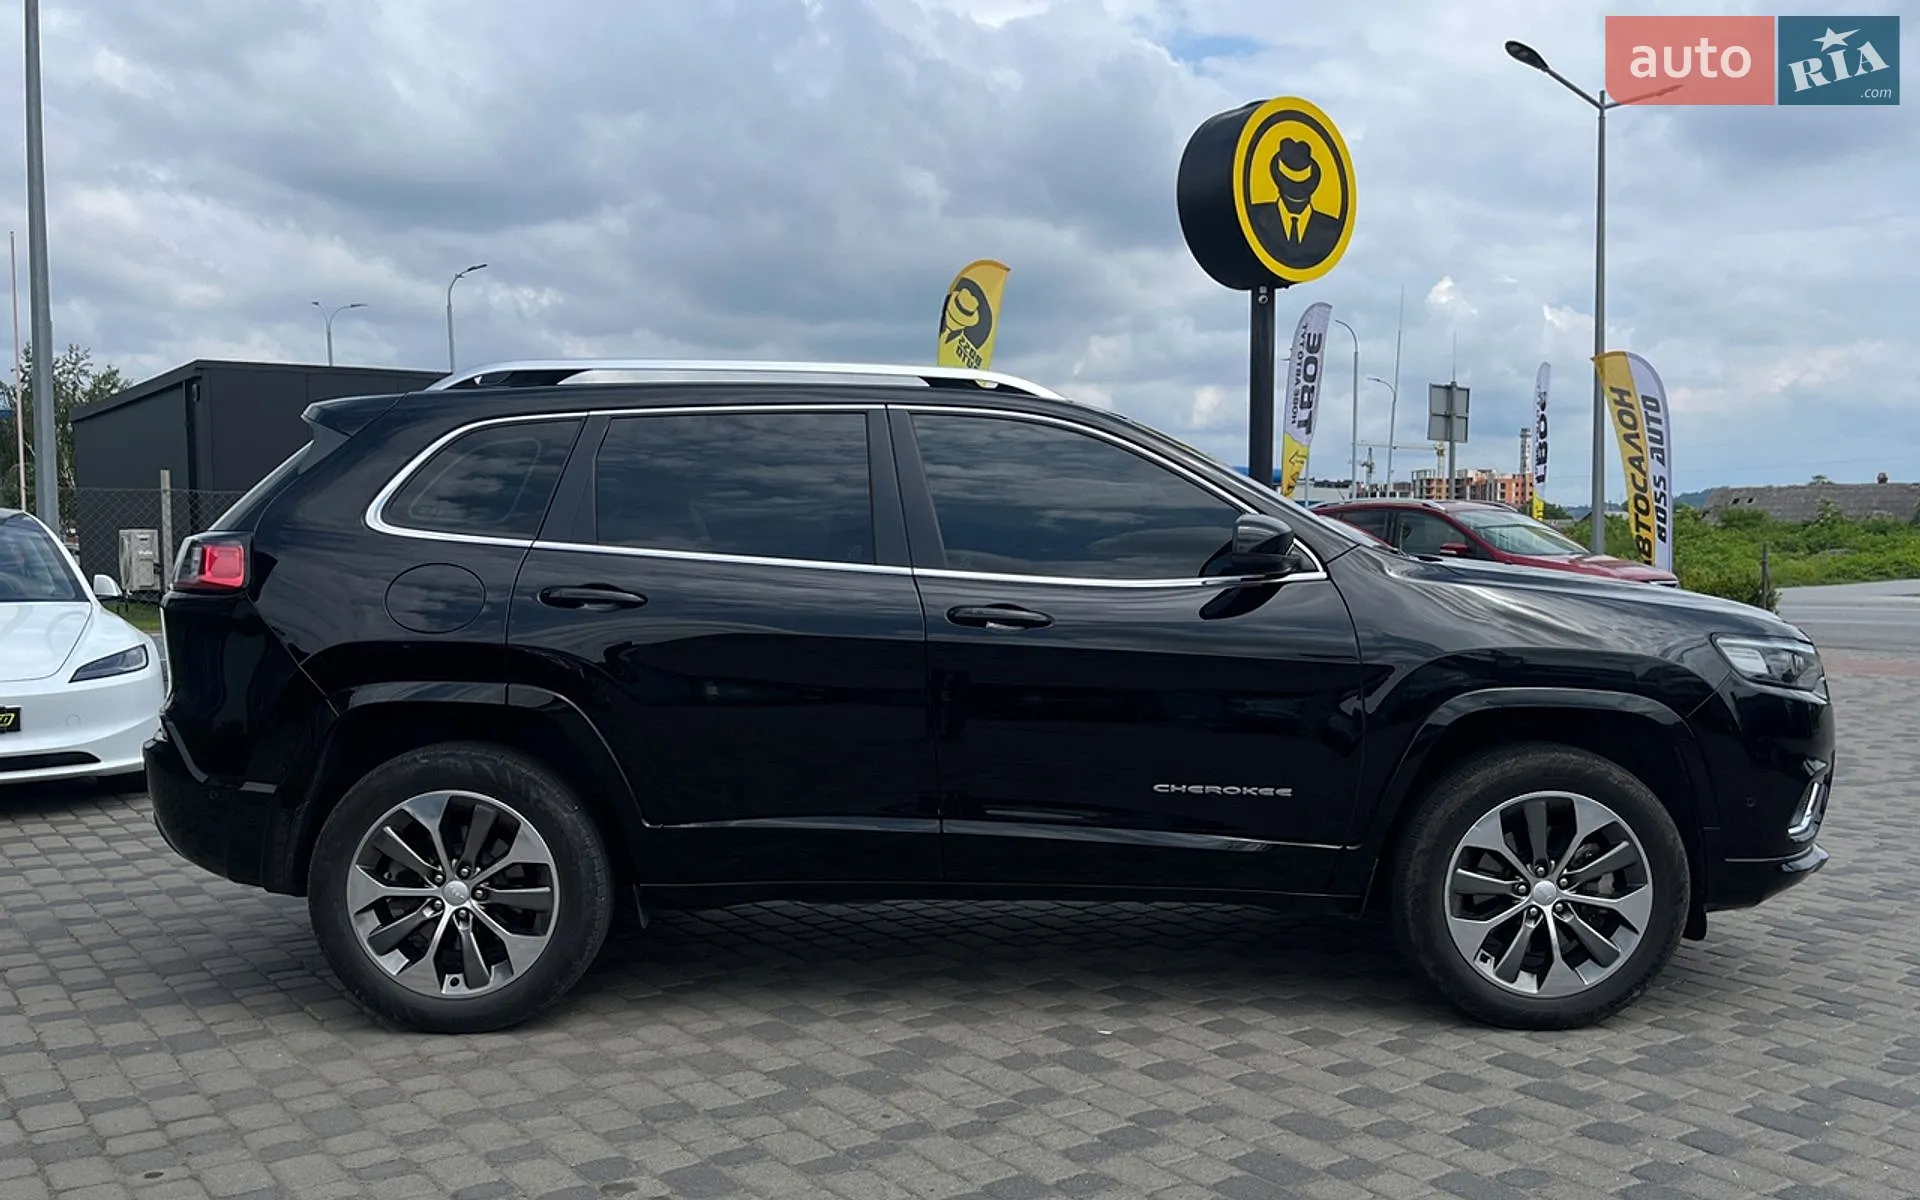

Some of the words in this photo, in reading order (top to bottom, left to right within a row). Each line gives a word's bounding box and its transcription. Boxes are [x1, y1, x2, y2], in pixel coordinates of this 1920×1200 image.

[1641, 394, 1666, 467] AUTO
[1653, 475, 1667, 544] BOSS
[1152, 783, 1293, 797] CHEROKEE
